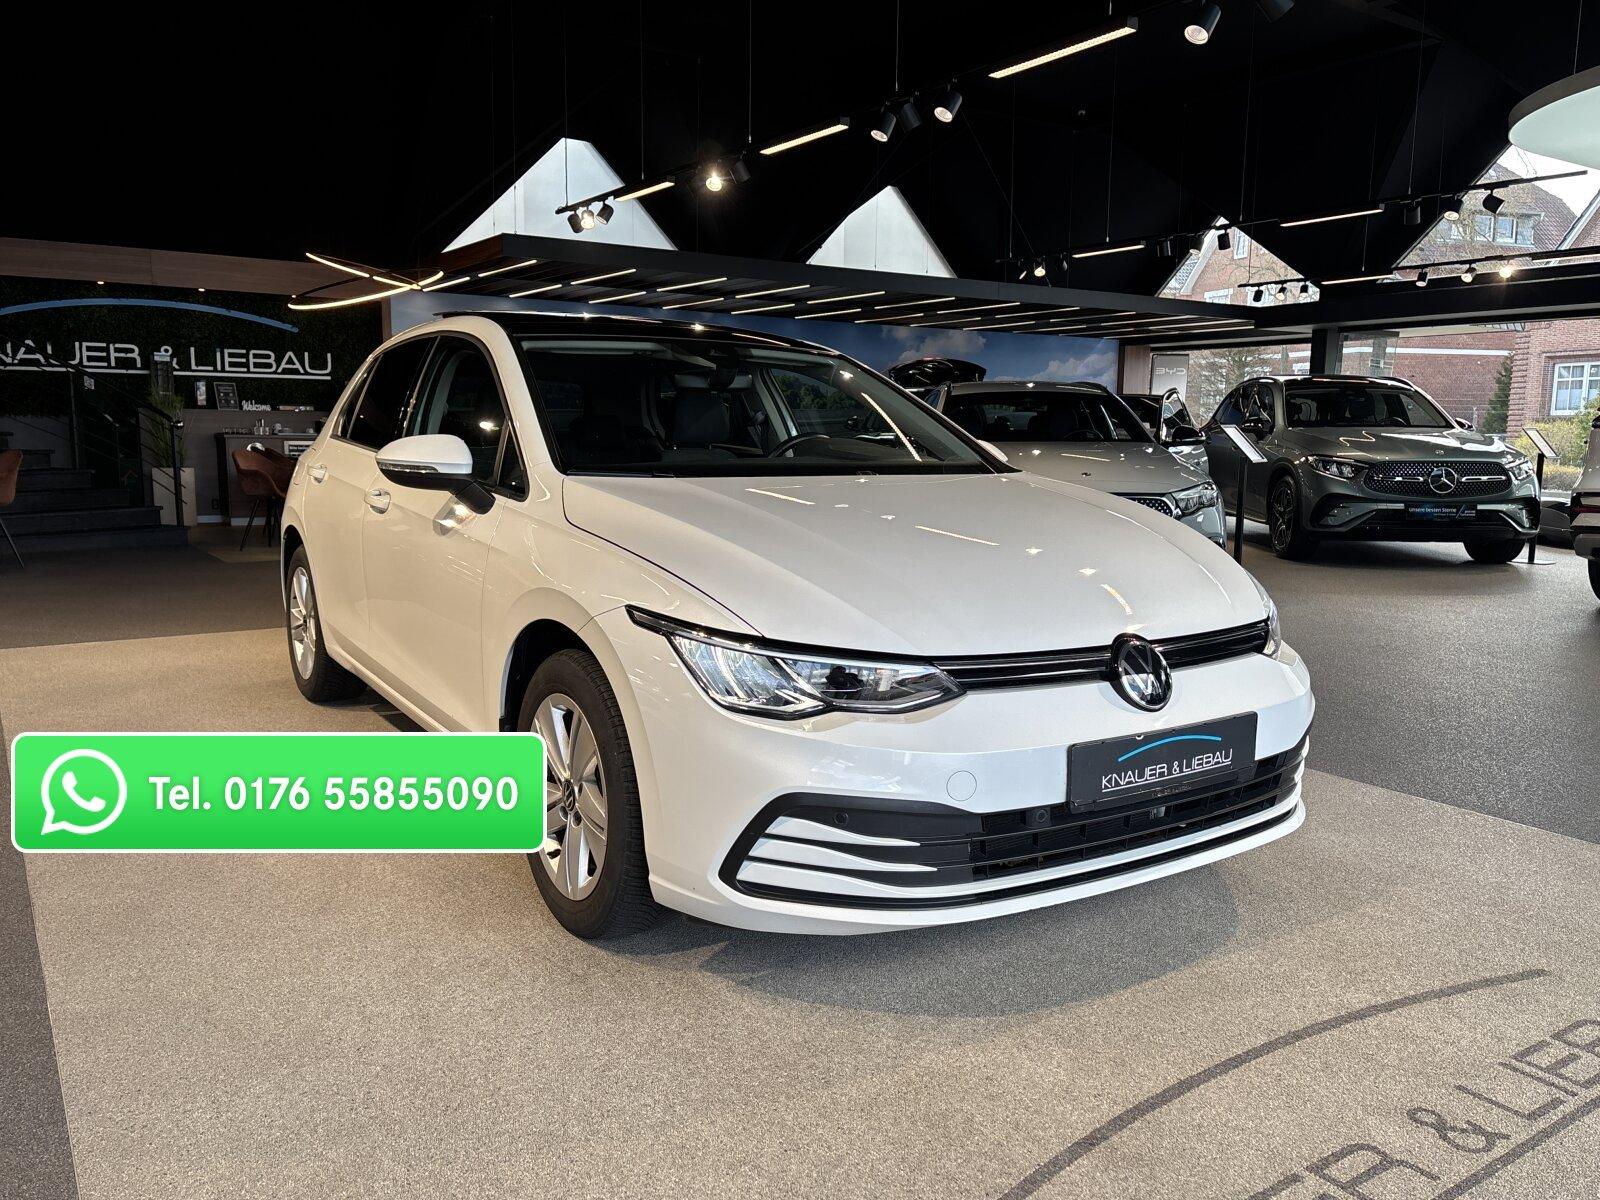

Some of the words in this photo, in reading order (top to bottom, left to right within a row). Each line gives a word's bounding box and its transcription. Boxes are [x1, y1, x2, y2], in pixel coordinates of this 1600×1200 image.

[189, 346, 332, 374] LIEBAU
[1155, 367, 1187, 375] BYD
[241, 400, 271, 412] Welcome
[1101, 763, 1168, 789] KNAUER
[1172, 760, 1180, 775] &
[1183, 748, 1233, 772] LIEBAU
[1406, 1106, 1511, 1153] &
